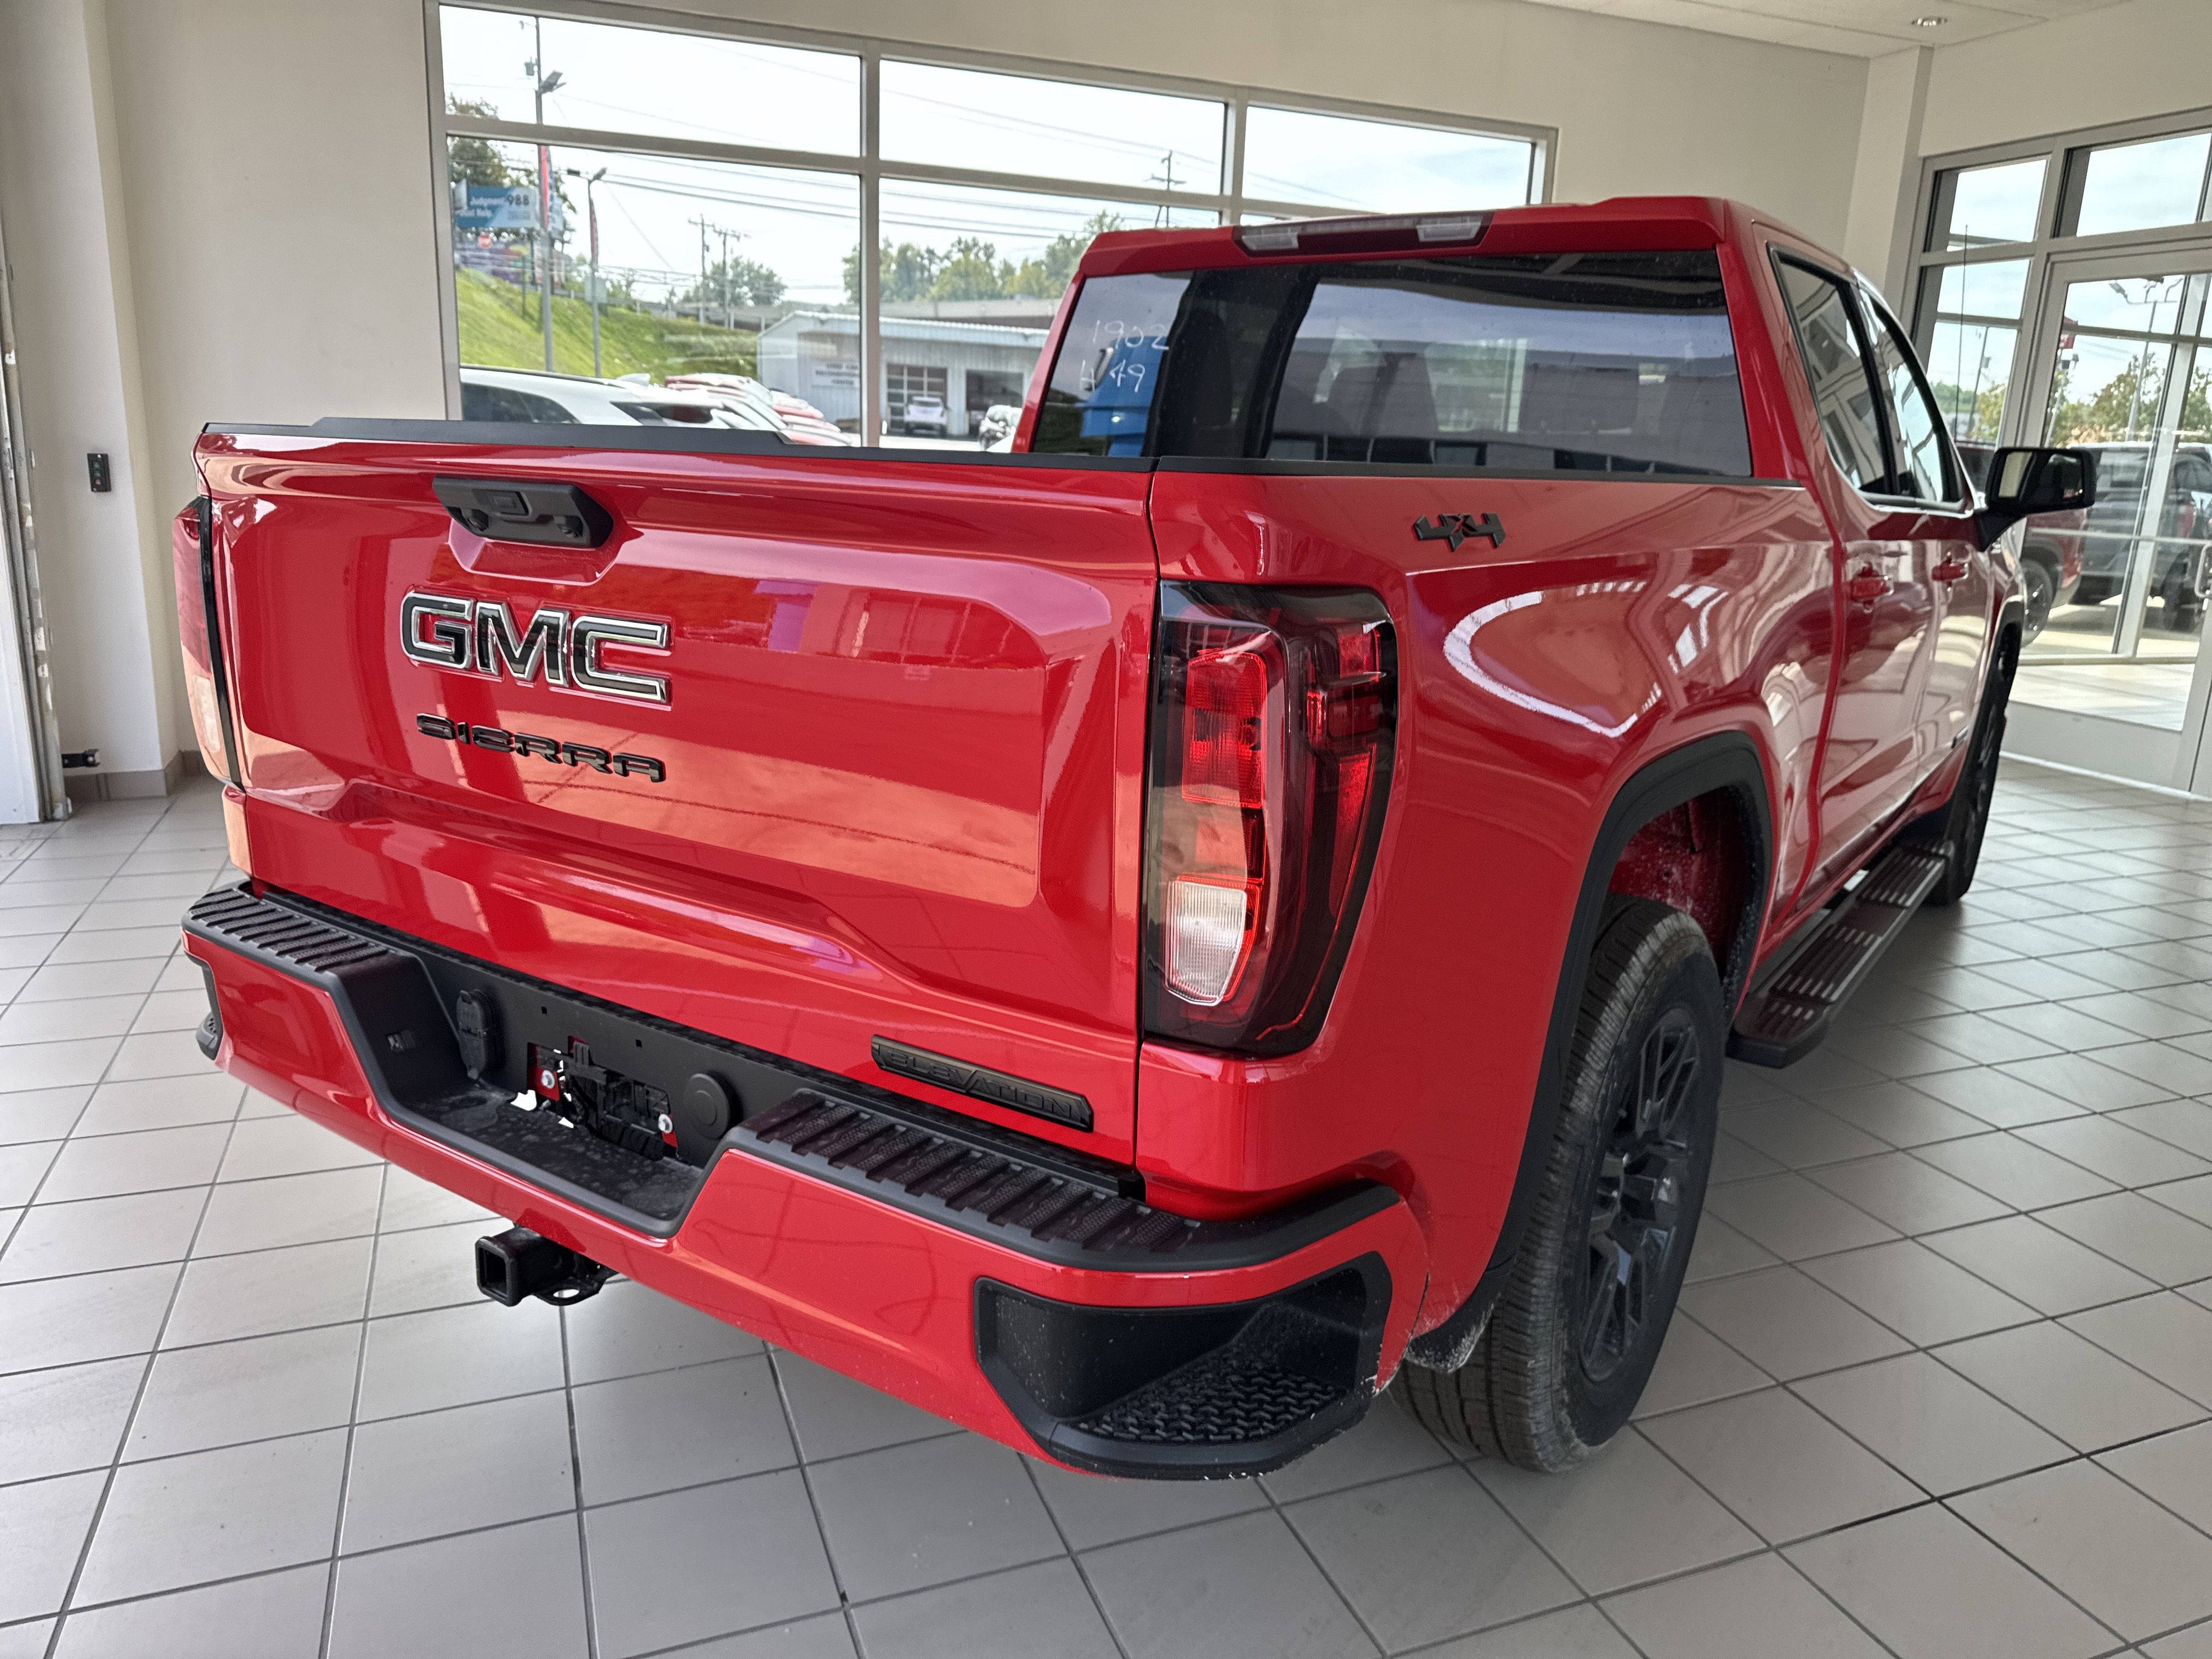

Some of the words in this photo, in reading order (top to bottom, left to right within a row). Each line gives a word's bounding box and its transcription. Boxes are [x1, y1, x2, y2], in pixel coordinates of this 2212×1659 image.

[507, 194, 529, 206] 988
[1091, 320, 1170, 350] 1902
[400, 591, 668, 703] GMC
[416, 713, 667, 783] SIERRA
[887, 1048, 1074, 1120] ELEVATION
